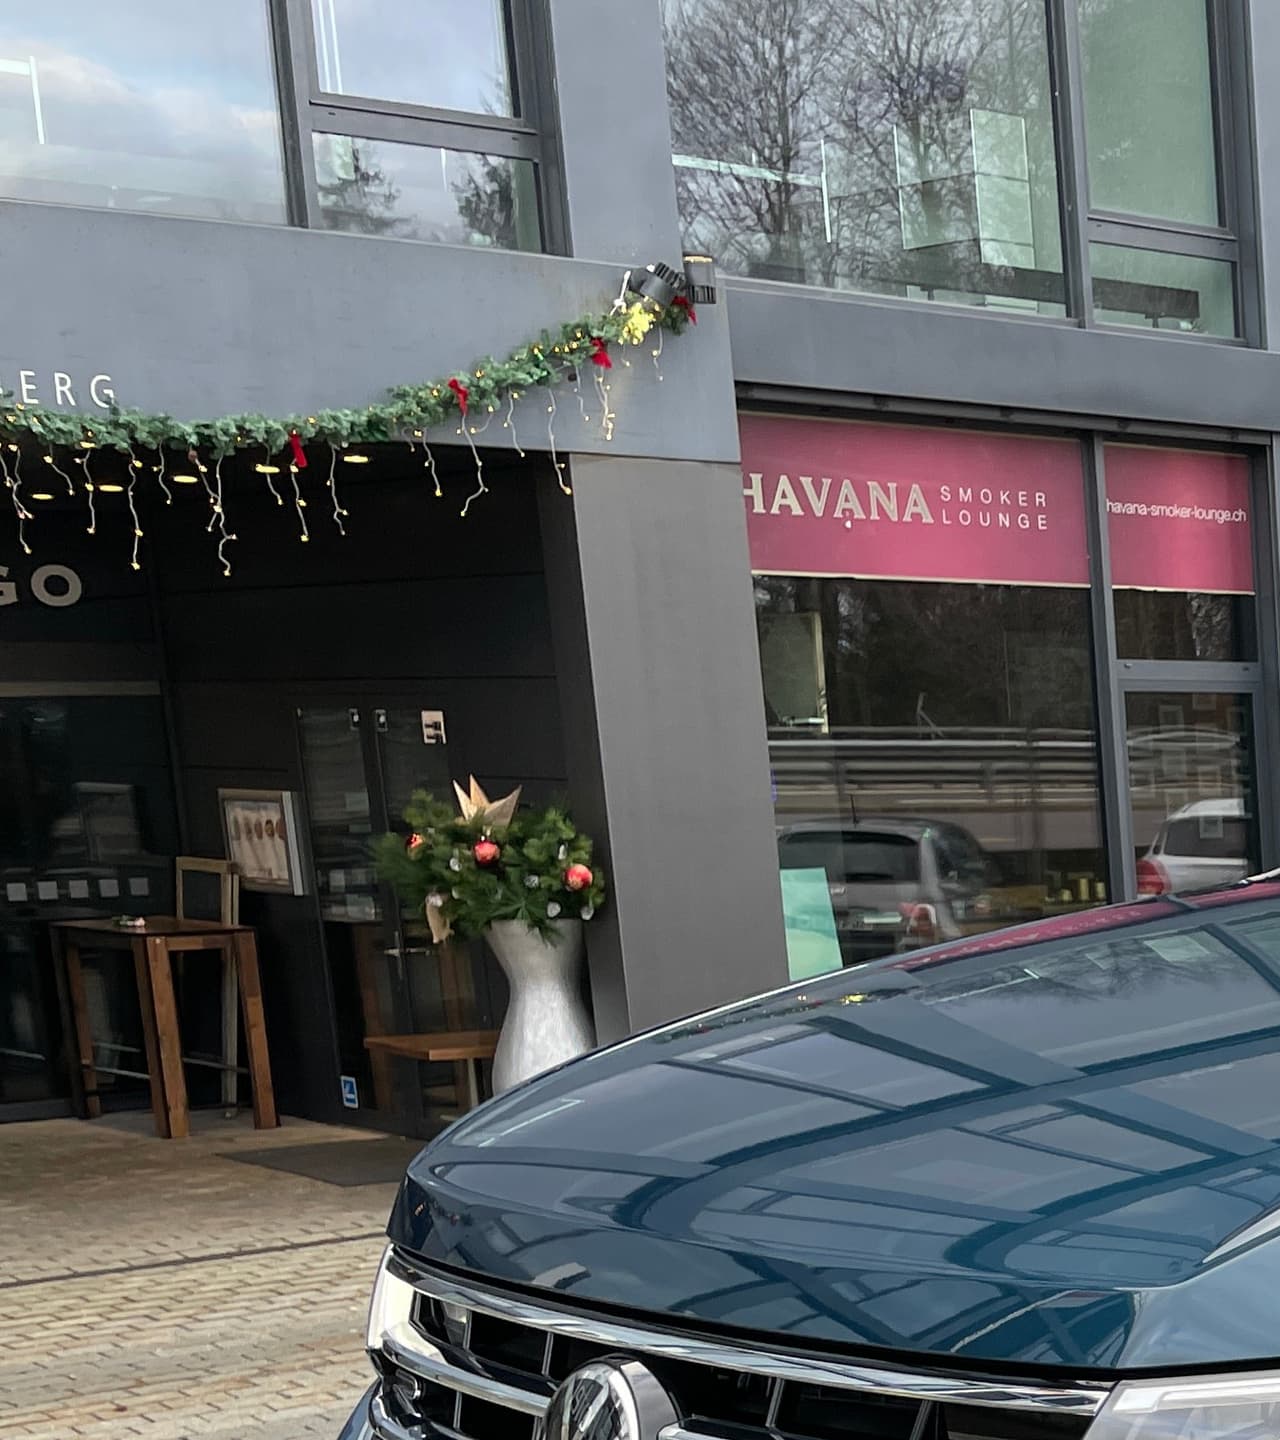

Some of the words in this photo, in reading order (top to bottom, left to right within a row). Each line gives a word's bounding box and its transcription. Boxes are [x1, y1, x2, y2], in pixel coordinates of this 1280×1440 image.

[0, 370, 115, 408] ERG
[743, 473, 934, 523] HAVANA
[940, 485, 1047, 507] SMOKER
[942, 509, 1048, 530] LOUNGE
[1106, 498, 1246, 524] havana-smoker-lounge.ch
